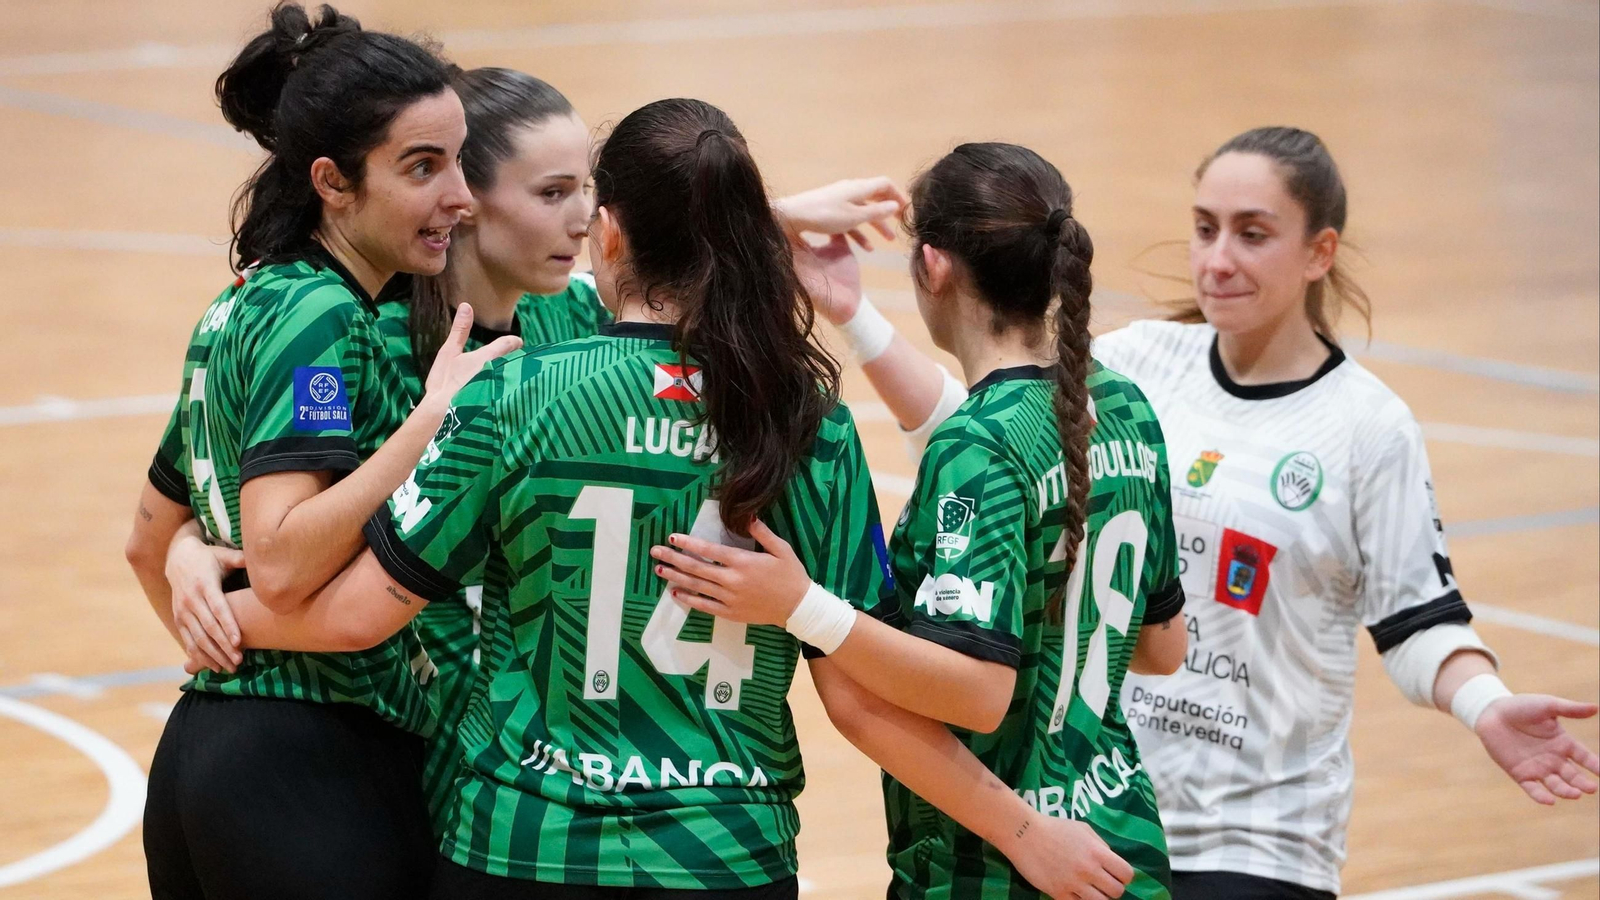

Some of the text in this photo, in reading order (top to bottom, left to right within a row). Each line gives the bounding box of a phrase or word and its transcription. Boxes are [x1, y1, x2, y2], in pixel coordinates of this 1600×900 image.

[333, 410, 347, 420] SALA
[937, 535, 960, 545] RFGF
[567, 485, 755, 711] 14
[1131, 686, 1248, 729] Deputación
[1127, 708, 1243, 750] Pontevedra
